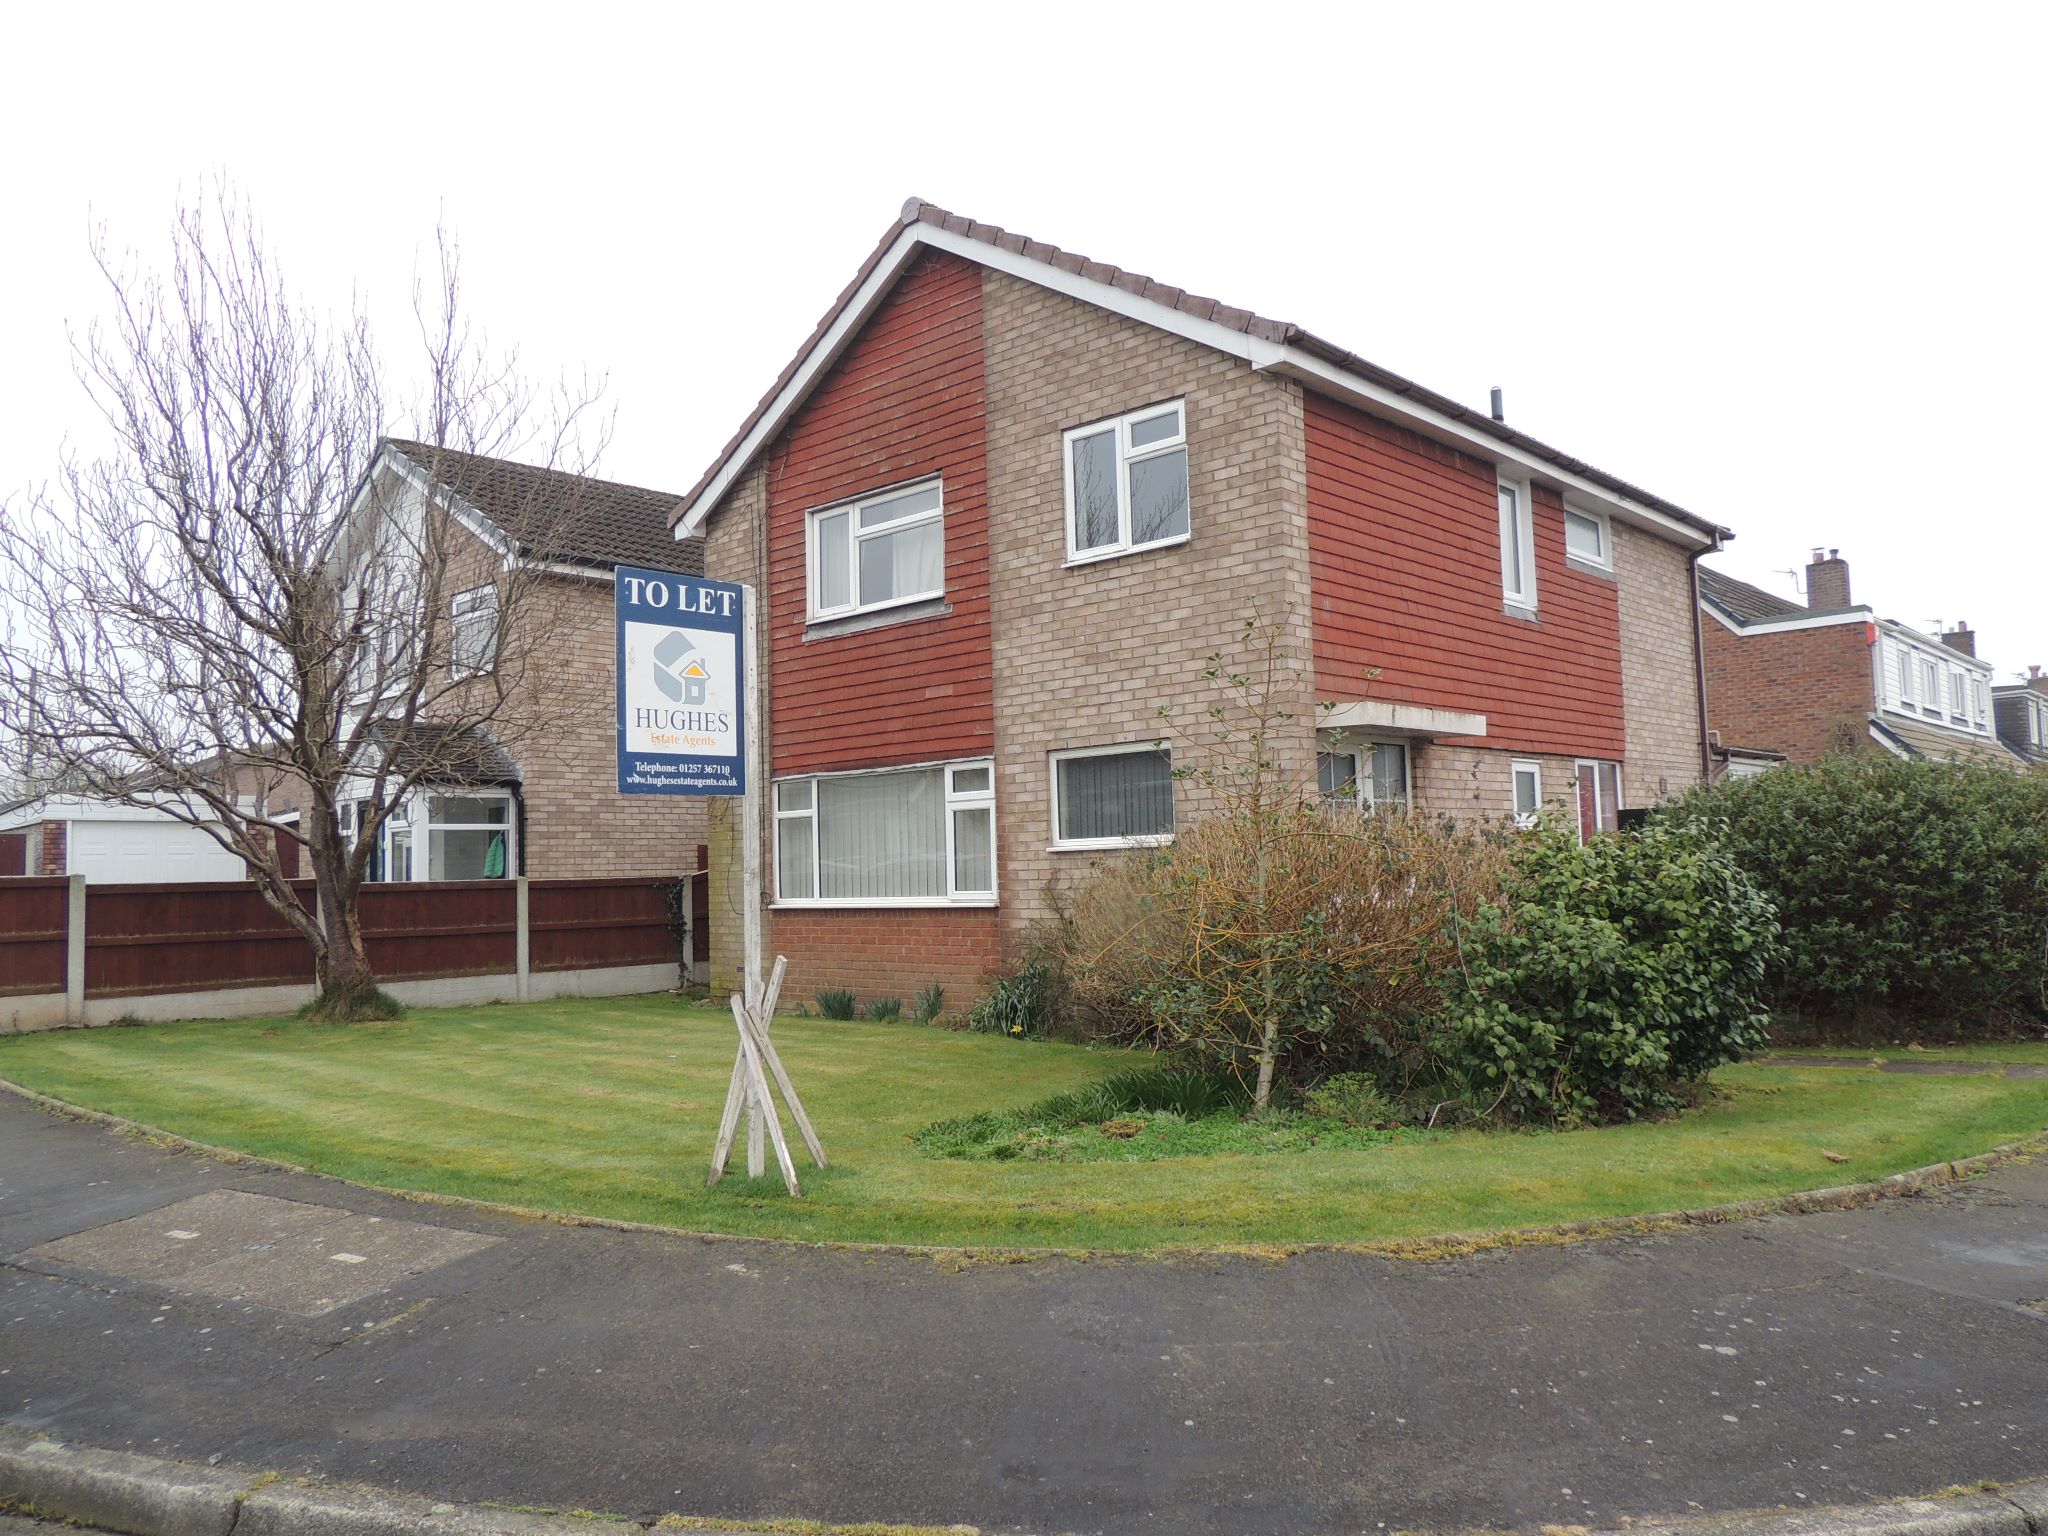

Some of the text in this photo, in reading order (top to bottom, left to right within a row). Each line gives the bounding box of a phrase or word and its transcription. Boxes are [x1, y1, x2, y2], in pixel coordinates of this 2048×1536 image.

[624, 577, 736, 617] TO LET
[635, 707, 729, 733] HUGHES
[650, 732, 716, 748] Estate Agents
[635, 761, 678, 775] Telephone:
[679, 763, 702, 774] 01257
[626, 775, 738, 787] www.hughesestateagents.co.uk
